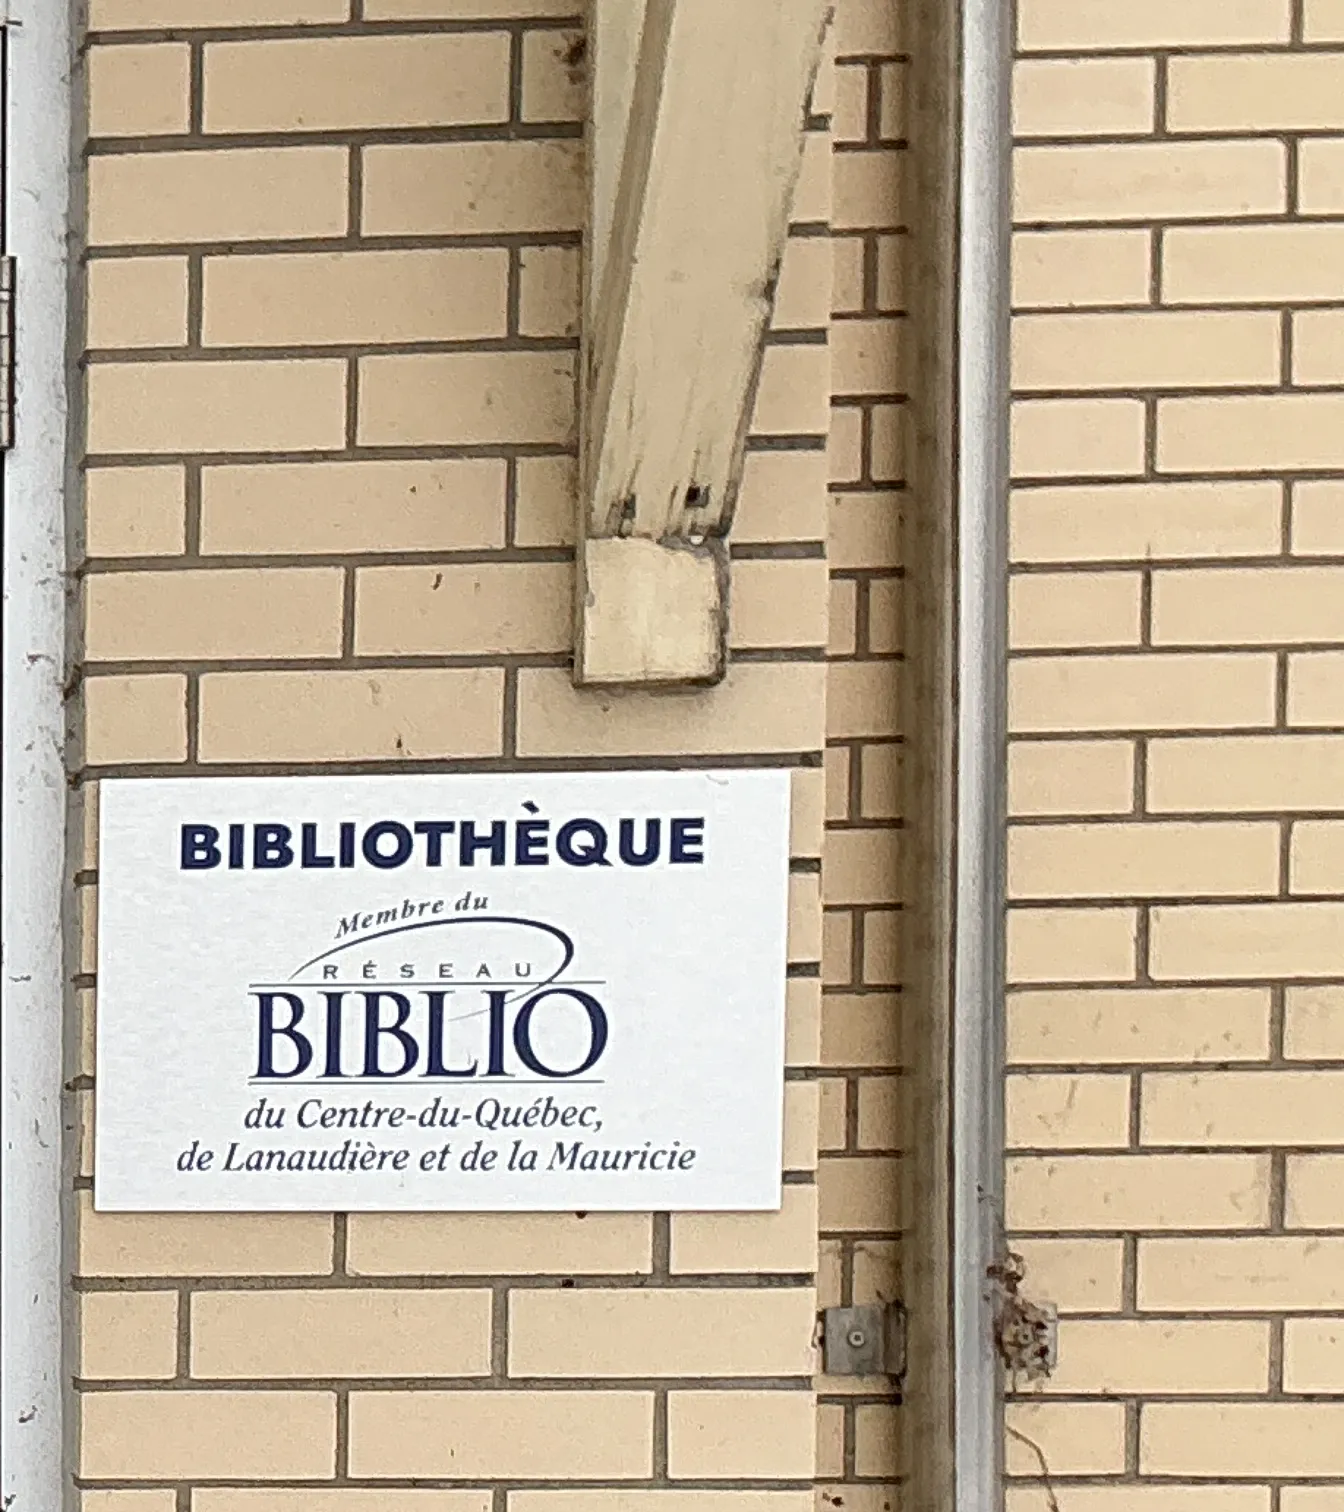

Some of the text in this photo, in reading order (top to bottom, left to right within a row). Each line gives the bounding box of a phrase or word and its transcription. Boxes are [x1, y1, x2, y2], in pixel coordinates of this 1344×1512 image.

[181, 801, 706, 870] BIBLIOTHÈQUE
[333, 891, 489, 940] Membre du
[322, 959, 533, 980] RÉSEAU
[248, 988, 610, 1080] BIBLIO
[244, 1097, 603, 1133] du Centre-du-Québec,
[176, 1141, 696, 1173] de Lanaudière et de la Mauricie
